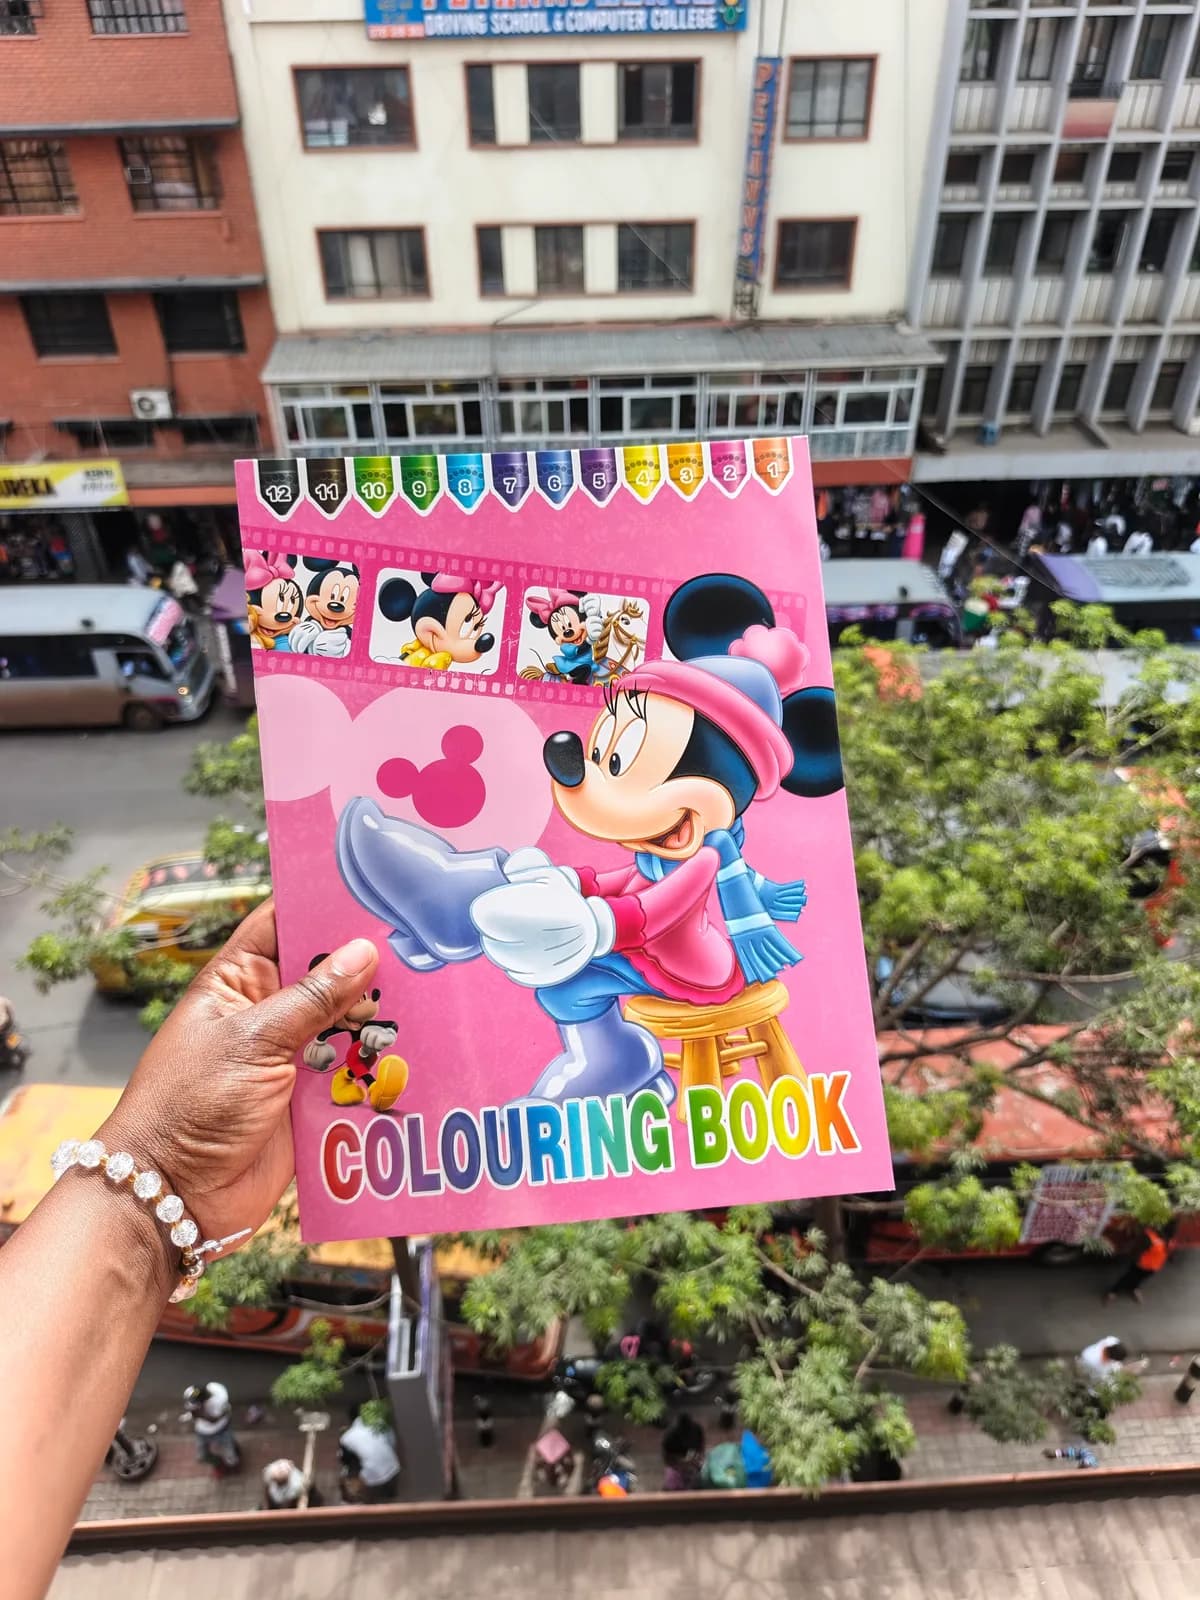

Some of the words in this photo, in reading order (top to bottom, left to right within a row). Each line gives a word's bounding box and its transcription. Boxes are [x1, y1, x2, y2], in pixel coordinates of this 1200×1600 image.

[424, 13, 487, 36] DRIVING
[490, 11, 550, 34] SCHOOL
[553, 12, 564, 31] &
[566, 9, 647, 32] COMPUTER
[651, 7, 717, 30] COLLEGE
[266, 485, 291, 502] 12
[315, 483, 340, 501] 11
[361, 482, 387, 499] 10
[412, 480, 427, 498] 9
[457, 478, 472, 496] 8
[503, 476, 518, 494] 7
[547, 475, 562, 493] 6
[592, 472, 606, 489] 5
[635, 469, 650, 487] 4
[679, 467, 694, 484] 3
[723, 464, 738, 481] 2
[767, 462, 780, 479] 1
[320, 1089, 675, 1204] COLOURING
[687, 1070, 862, 1169] BOOK
